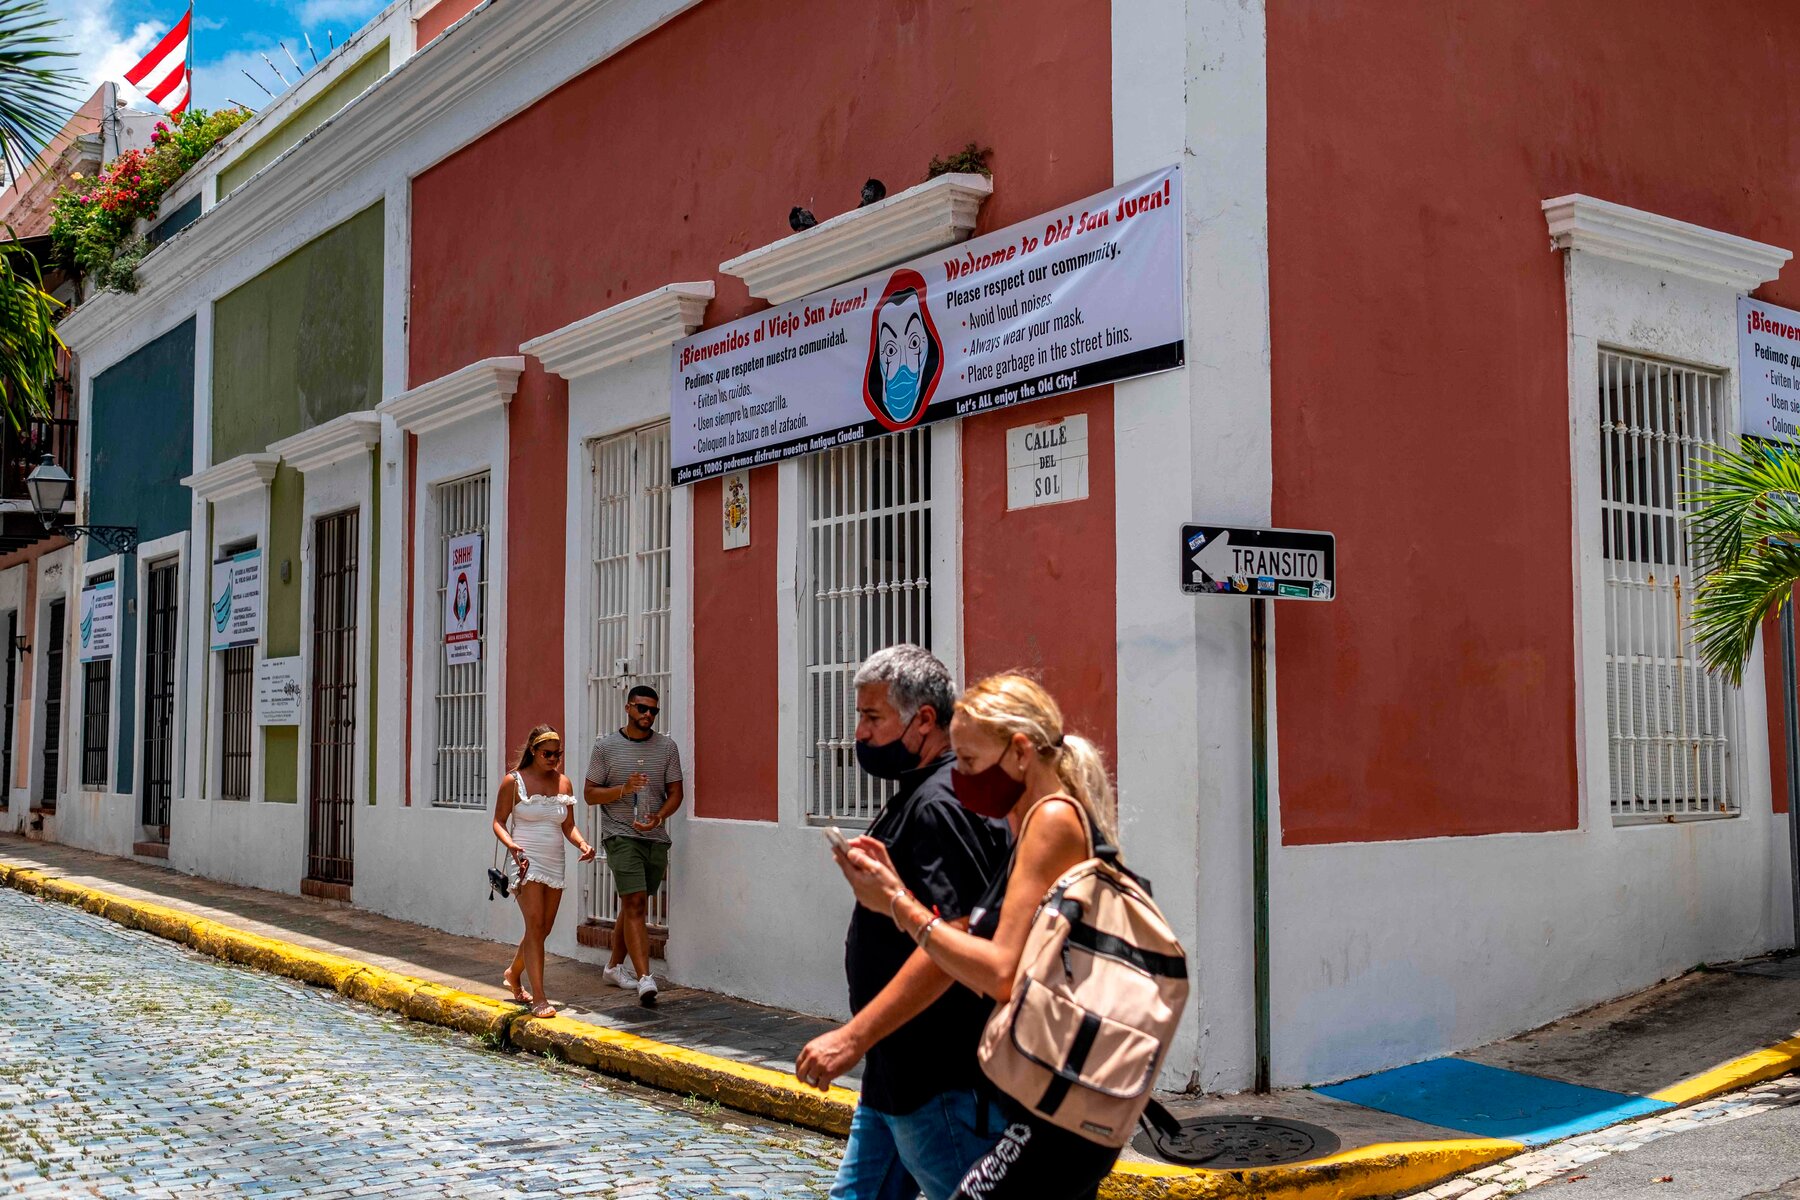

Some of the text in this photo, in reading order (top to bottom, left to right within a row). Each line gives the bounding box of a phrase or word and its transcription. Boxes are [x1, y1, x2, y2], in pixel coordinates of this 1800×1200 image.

[944, 179, 1170, 282] Welcome to Old San Juan!
[946, 241, 1121, 309] Please respect our community.
[680, 288, 867, 372] ¡Bienvenidos al Viejo San Juan!
[969, 293, 1052, 330] Avoid loud noises.
[969, 307, 1084, 356] Always wear your mask.
[685, 328, 847, 390] Pedimos que respeten nuestra comunidad.
[968, 327, 1132, 383] Place garbage in the street bins.
[1755, 342, 1788, 365] Pedimos
[698, 384, 752, 409] Eviten los ruidos.
[956, 372, 1077, 414] Let's ALL enjoy the Old City!
[1771, 370, 1791, 386] Eviten
[698, 395, 788, 430] Usen siempre la mascarilla.
[1772, 393, 1788, 411] Usen
[698, 414, 808, 454] Coloquen la basura en el zafacón.
[704, 461, 722, 474] TODOS
[724, 455, 752, 472] podremos
[754, 449, 781, 462] disfrutar
[783, 444, 808, 457] nuestra
[810, 436, 835, 451] Antigua
[838, 426, 863, 443] Ciudad!
[1025, 426, 1067, 451] CALLE
[1040, 455, 1056, 469] DEL
[1035, 475, 1060, 497] SOL
[1232, 549, 1317, 578] TRANSITO
